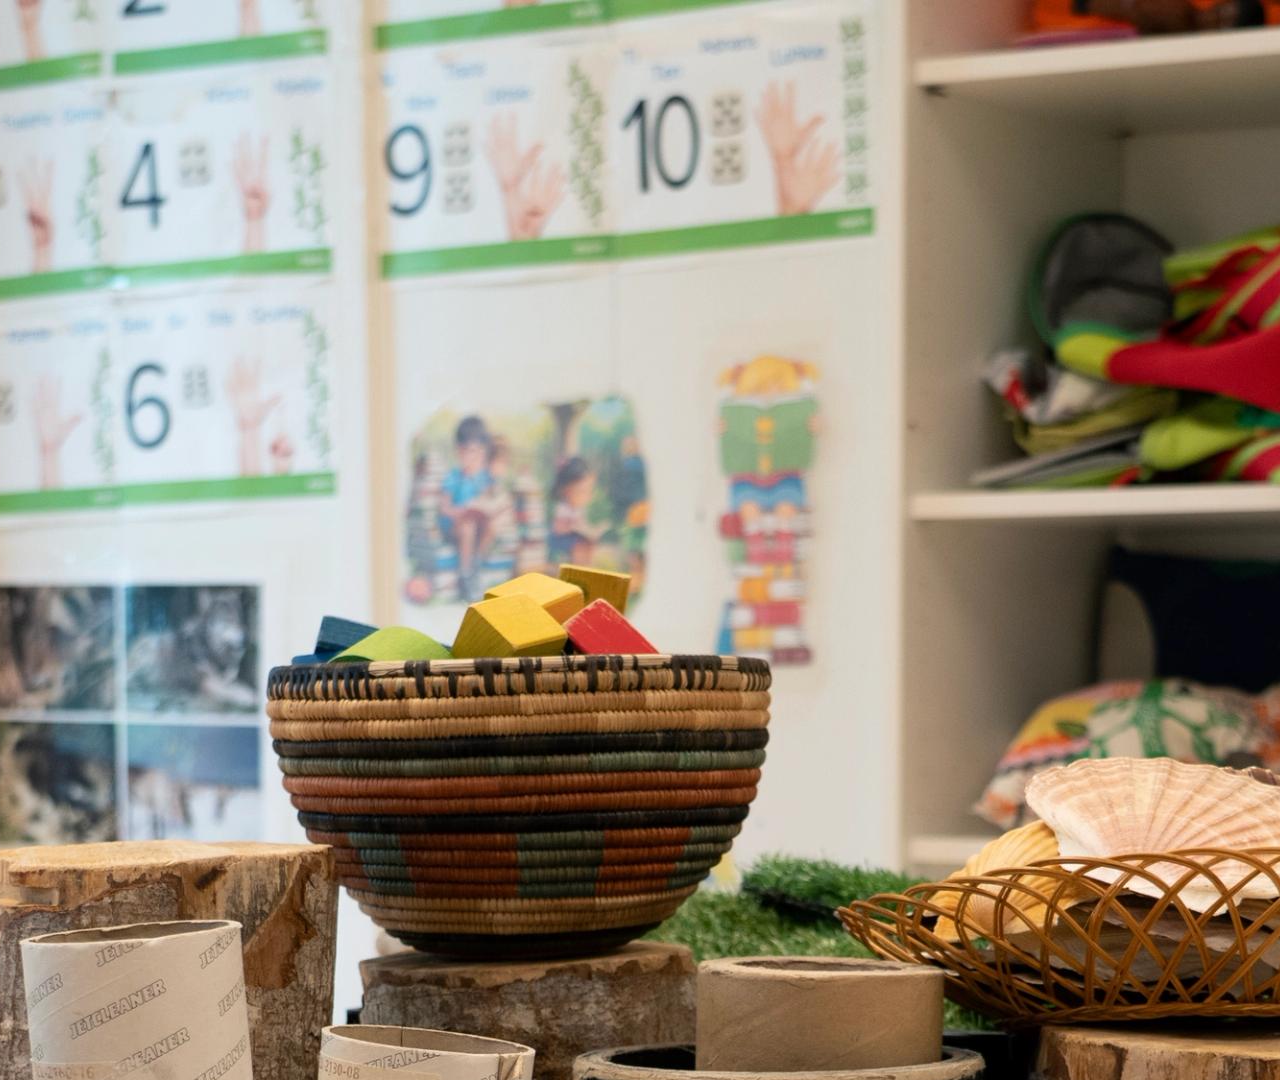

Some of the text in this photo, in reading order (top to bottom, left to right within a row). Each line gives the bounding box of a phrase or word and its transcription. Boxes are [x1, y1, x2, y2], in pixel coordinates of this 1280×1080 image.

[121, 141, 168, 229] 4
[384, 125, 433, 217] 9
[621, 95, 700, 193] 10
[126, 362, 171, 450] 6
[69, 979, 167, 1040] JETCLEANER
